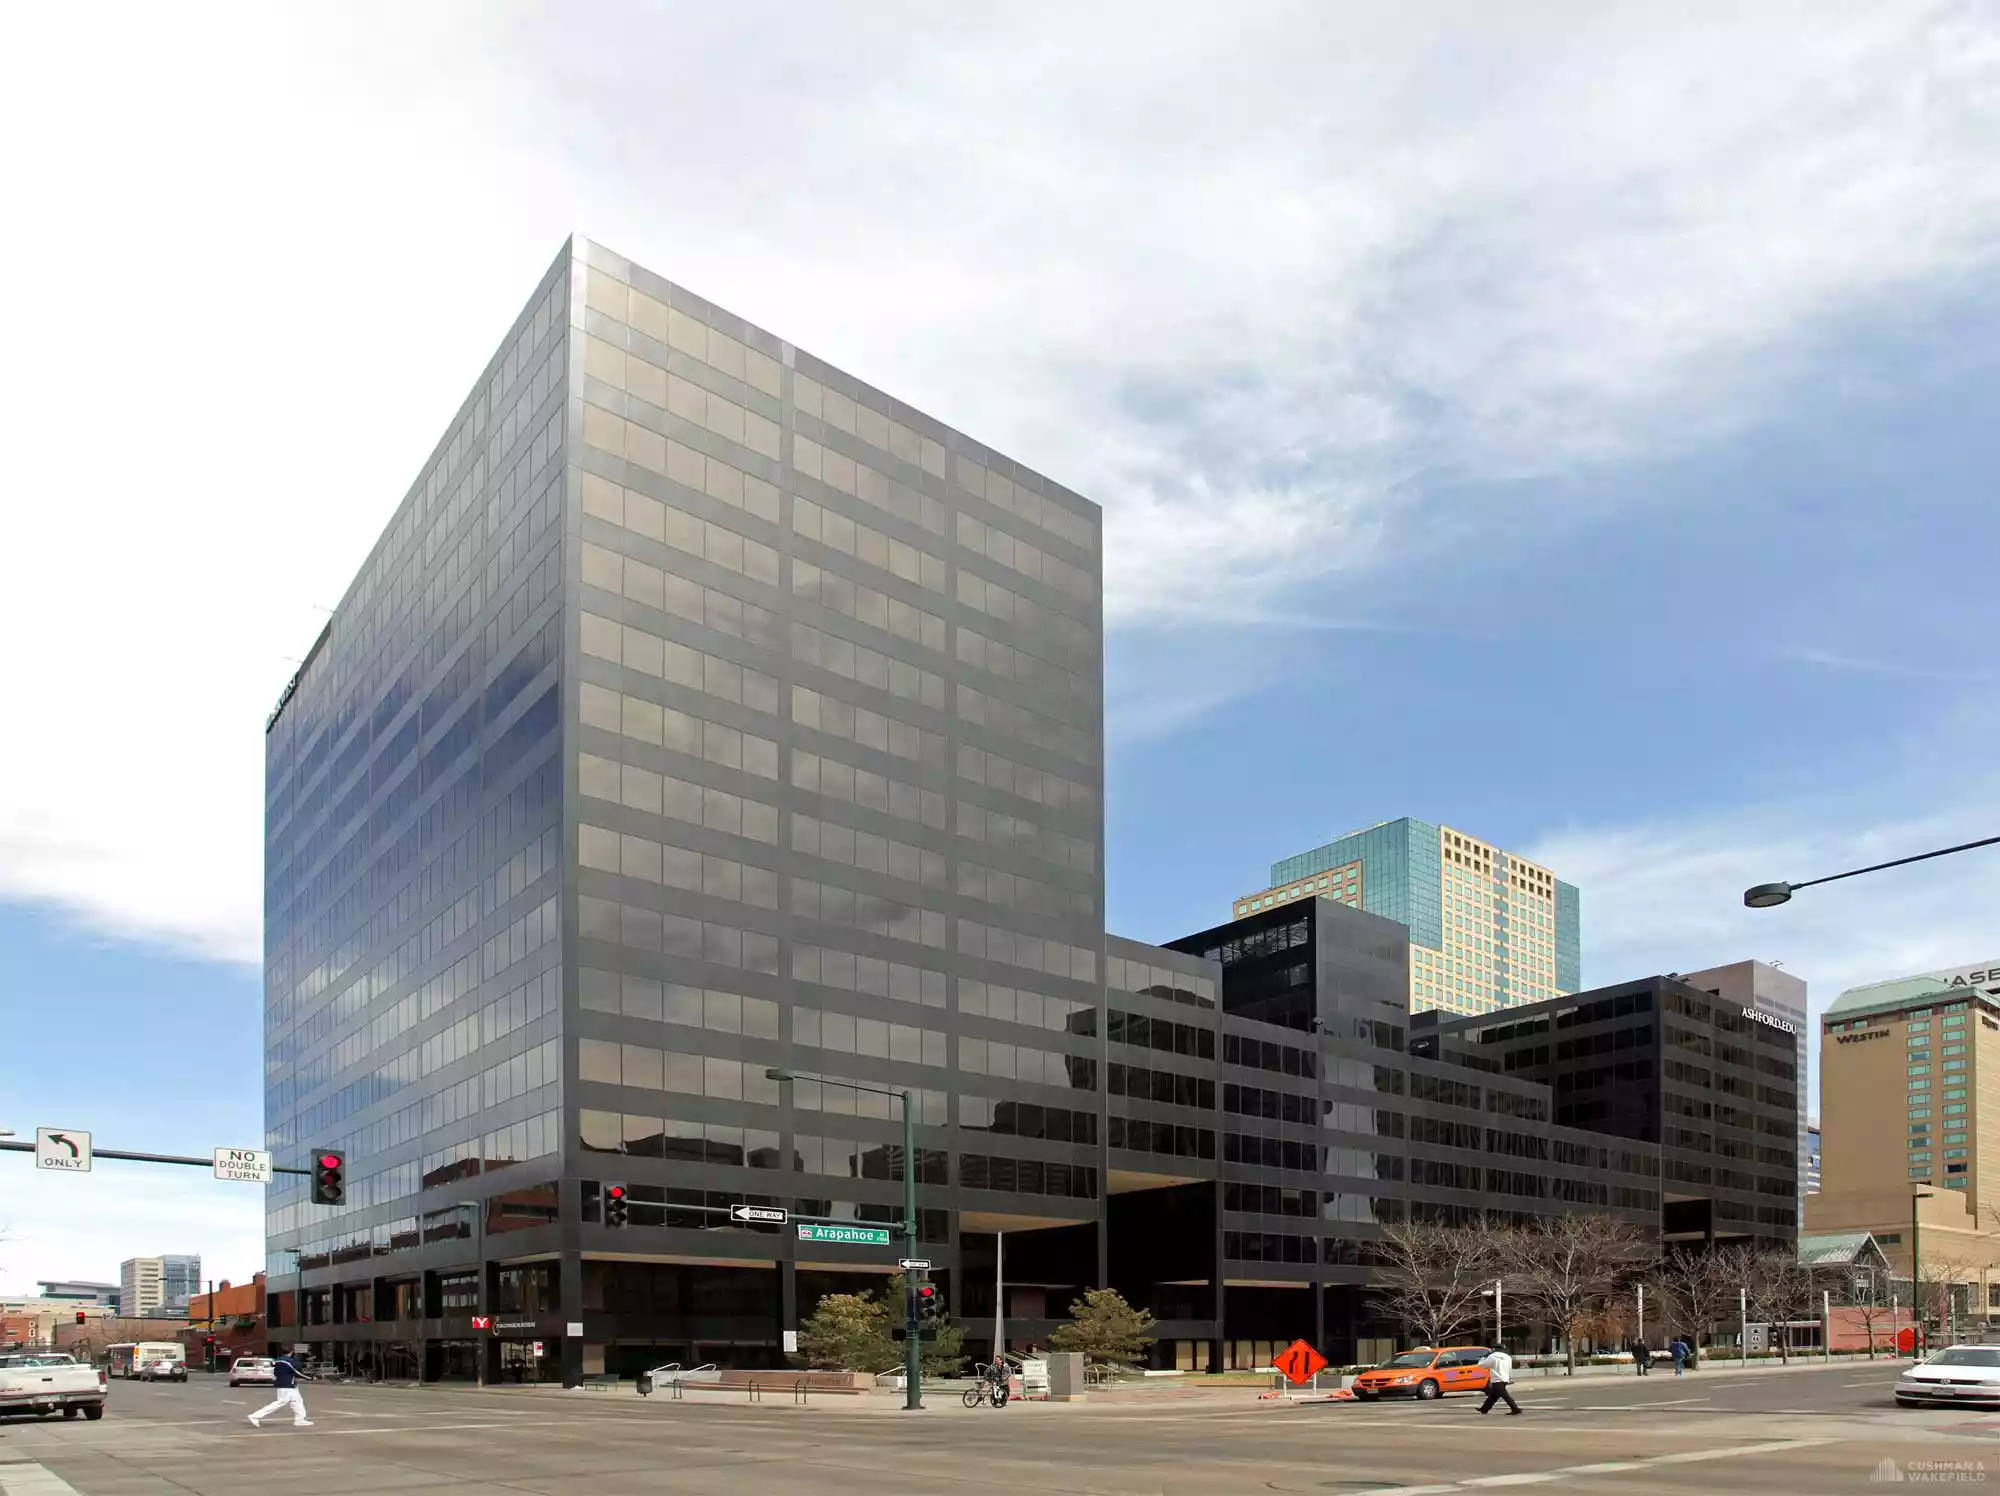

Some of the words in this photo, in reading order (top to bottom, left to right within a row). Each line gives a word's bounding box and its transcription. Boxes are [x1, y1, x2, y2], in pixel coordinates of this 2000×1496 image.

[1943, 967, 2000, 986] ASE
[1836, 1029, 1890, 1044] WESTIN
[230, 1151, 255, 1161] NO
[44, 1157, 82, 1168] ONLY
[220, 1161, 267, 1171] DOUBLE
[227, 1171, 260, 1180] TURN
[749, 1210, 765, 1218] ONE
[816, 1228, 874, 1241] Arapahoe
